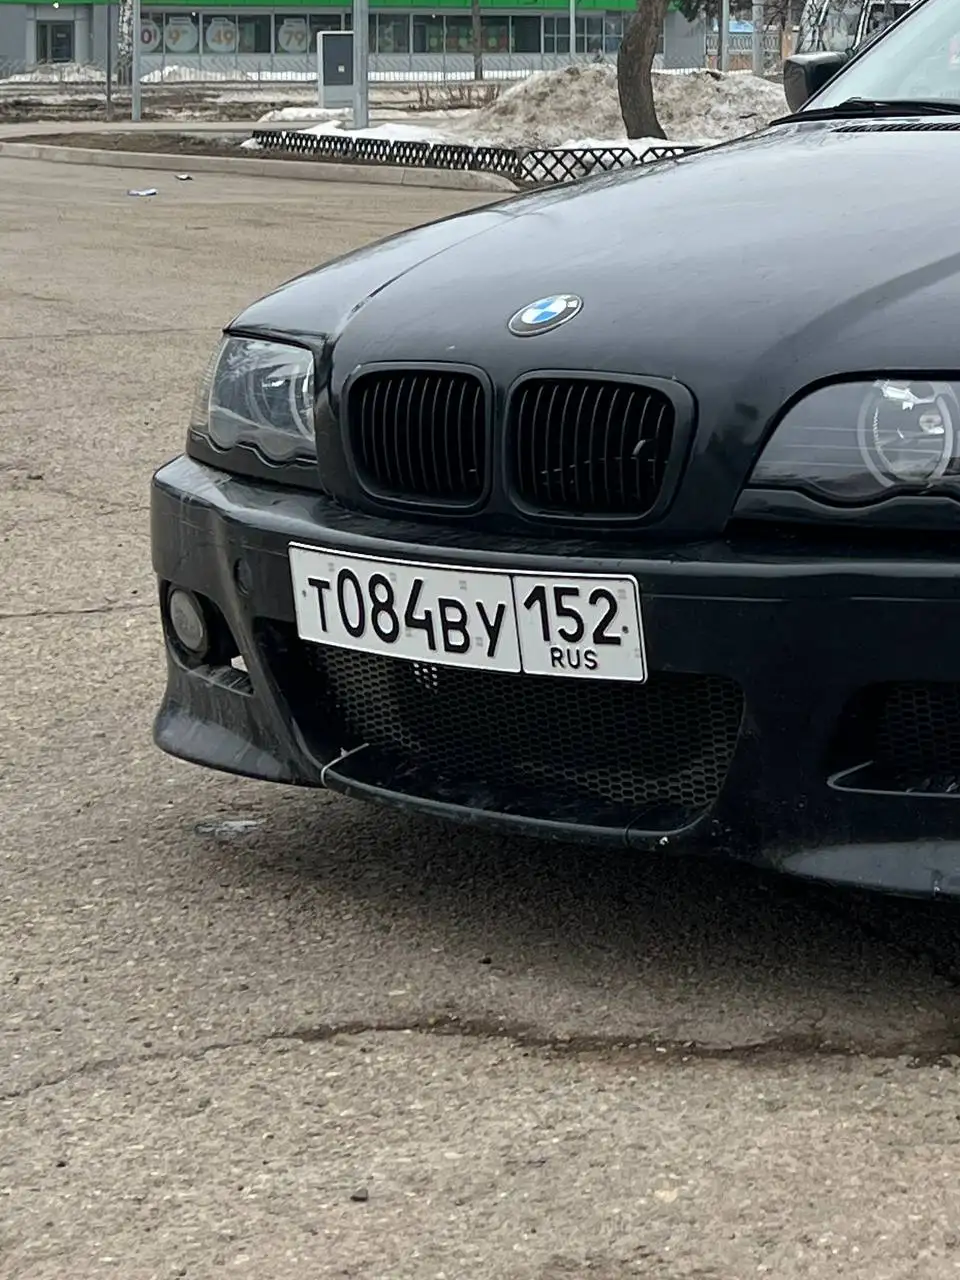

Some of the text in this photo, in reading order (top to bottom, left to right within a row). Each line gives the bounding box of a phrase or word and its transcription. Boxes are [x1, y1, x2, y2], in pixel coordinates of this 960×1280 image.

[307, 568, 622, 658] Т084ВУ 152
[550, 646, 599, 671] RUS
